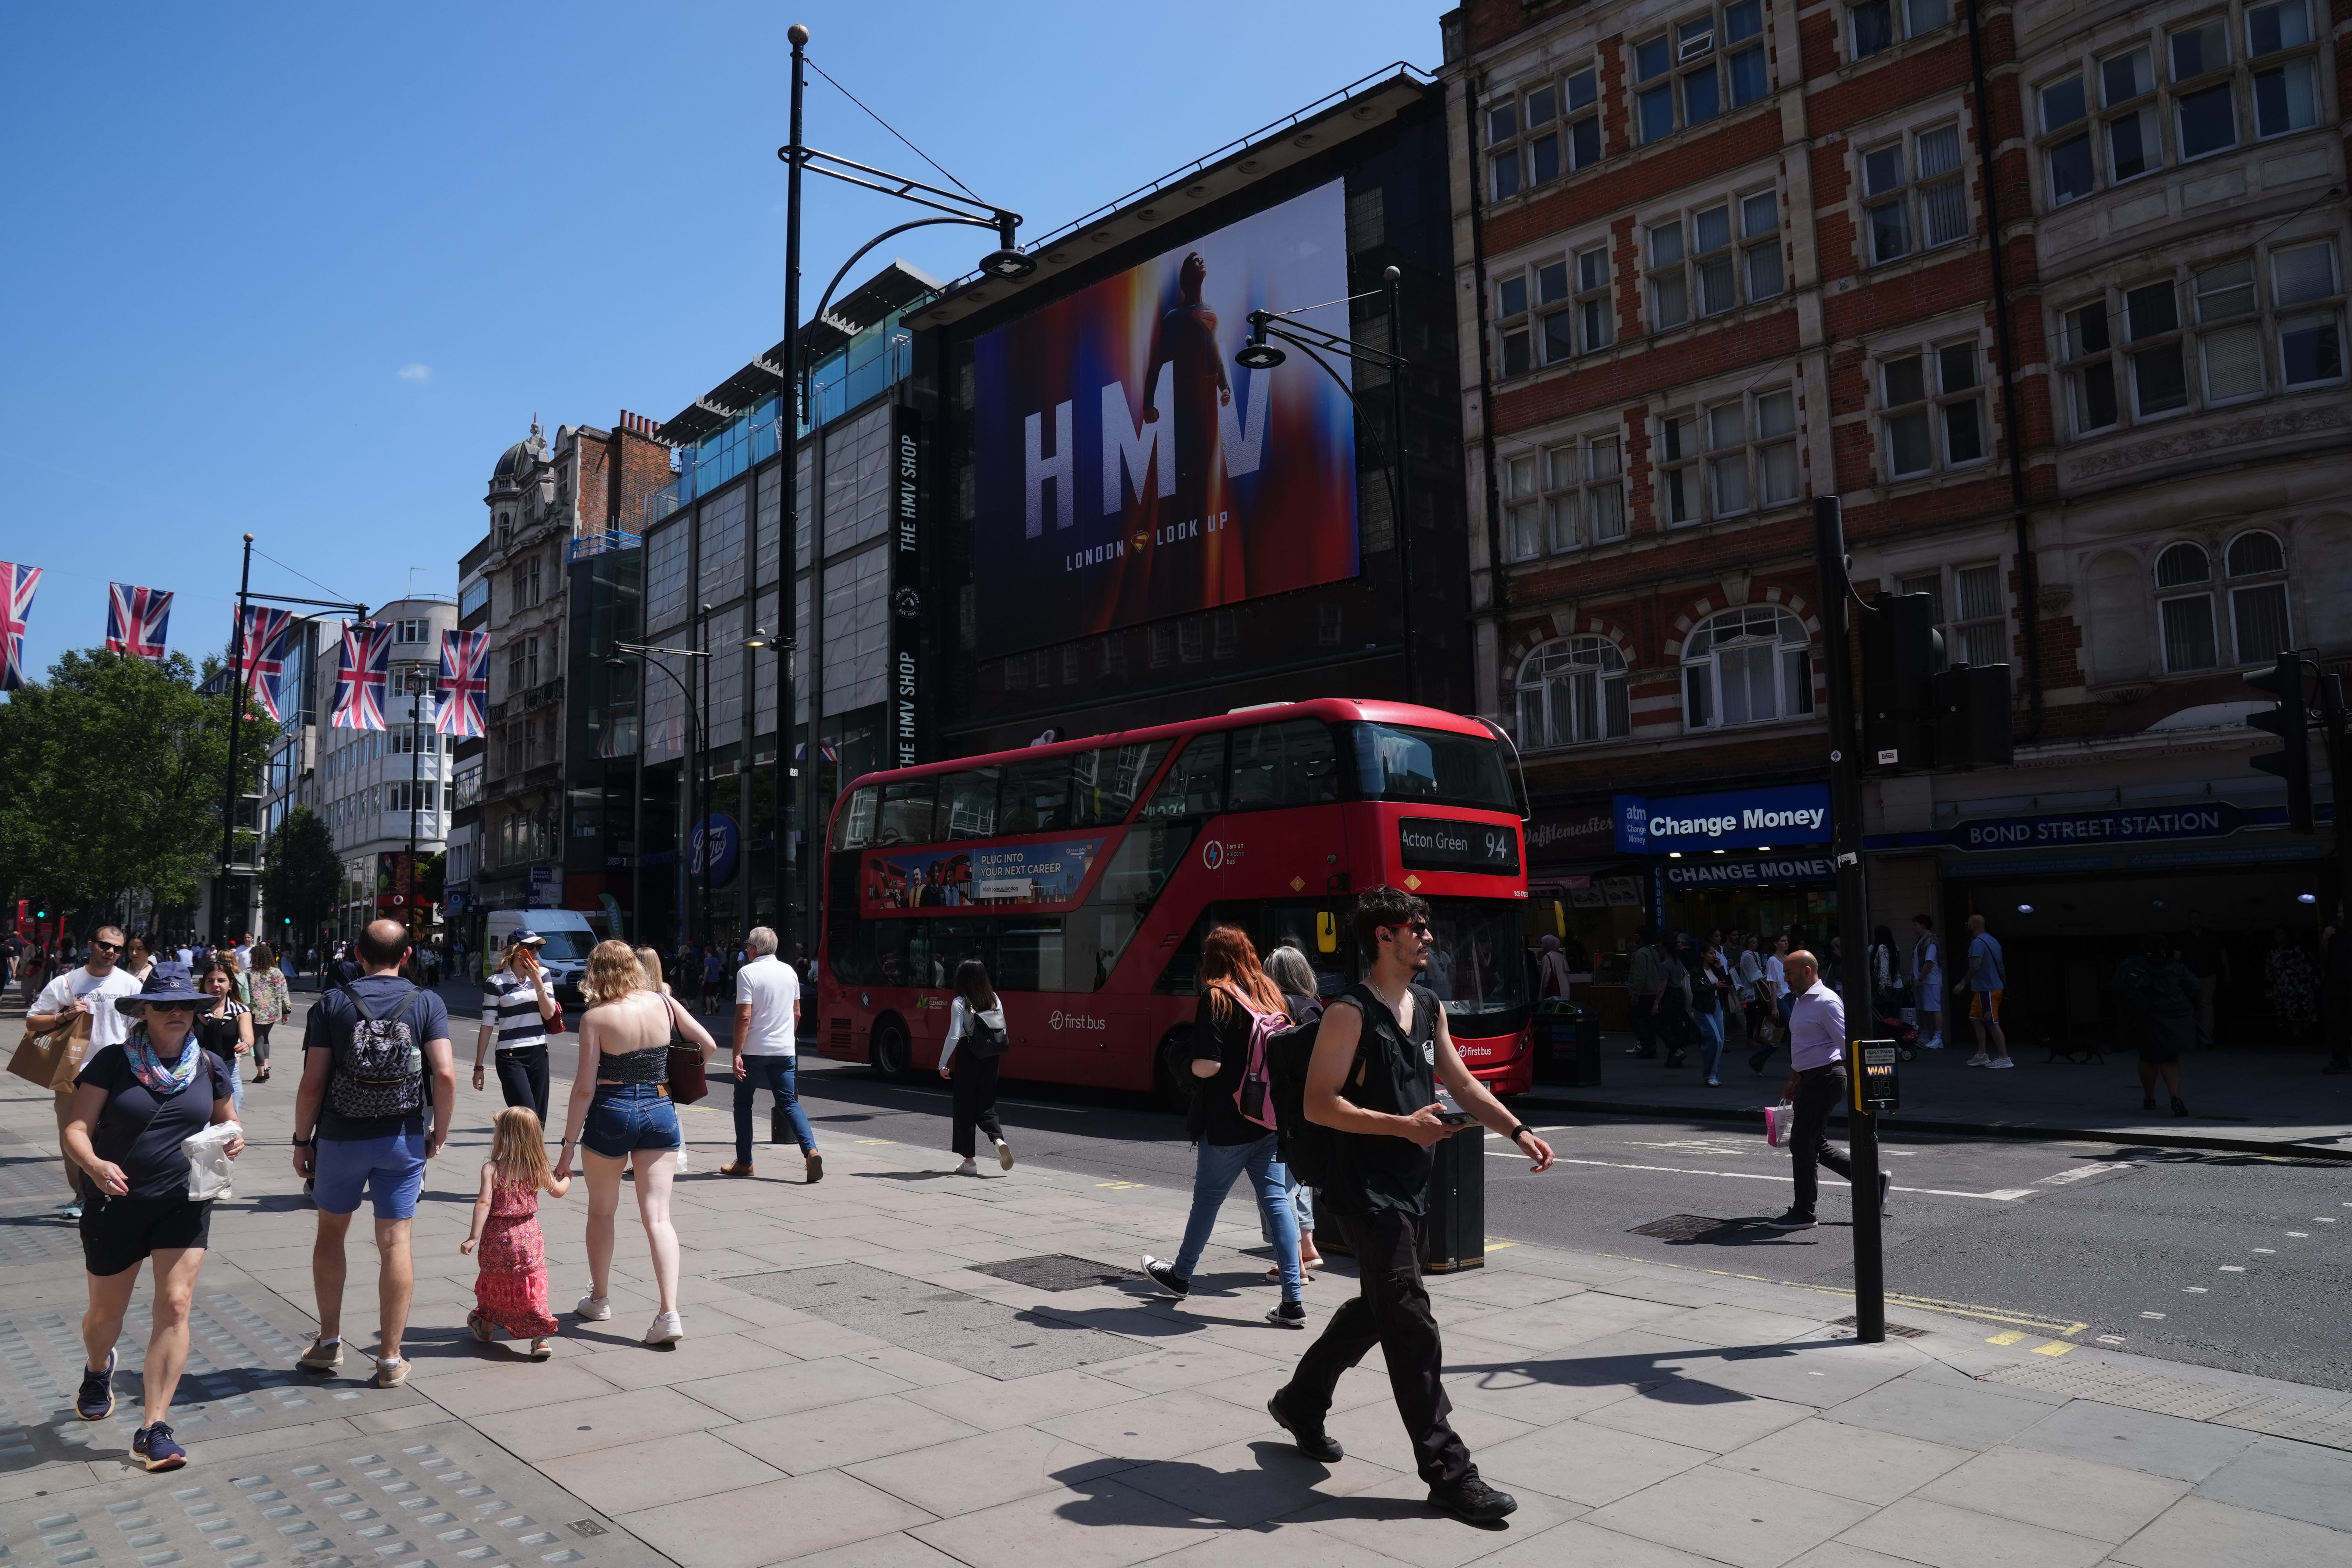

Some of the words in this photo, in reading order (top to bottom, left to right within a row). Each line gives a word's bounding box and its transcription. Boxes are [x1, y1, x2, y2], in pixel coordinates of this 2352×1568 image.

[1025, 321, 1274, 540] HMV
[901, 435, 916, 478] SHOP
[901, 480, 916, 519] HMV
[901, 521, 916, 552] THE
[1067, 539, 1124, 572] LONDON
[1156, 519, 1198, 546] LOOK
[1207, 511, 1228, 533] UP
[911, 590, 920, 604] SHOP
[900, 652, 915, 696] SHOP
[900, 699, 915, 738] HMV
[1626, 804, 1646, 821] atm
[1650, 816, 1737, 837] Change
[1743, 808, 1825, 829] Money
[1403, 829, 1432, 848] Acton
[1436, 832, 1468, 851] Green
[1627, 824, 1646, 835] Change
[1970, 824, 2031, 844] BOND
[2037, 818, 2114, 840] STREET
[2121, 811, 2220, 834] STATION
[691, 825, 728, 875] Bots
[1485, 832, 1507, 858] 94
[1628, 835, 1646, 846] Money
[981, 854, 1002, 865] PLUG
[1004, 852, 1024, 863] INTO
[981, 866, 1003, 877] YOUR
[1005, 865, 1026, 876] NEXT
[1027, 862, 1061, 874] CAREER
[1668, 863, 1757, 883] CHANGE
[1760, 859, 1836, 879] MONEY
[1065, 1014, 1085, 1028] first
[1087, 1014, 1105, 1030] bus
[1468, 1047, 1480, 1056] first
[1481, 1047, 1492, 1055] bus
[1867, 1065, 1892, 1076] WAIT
